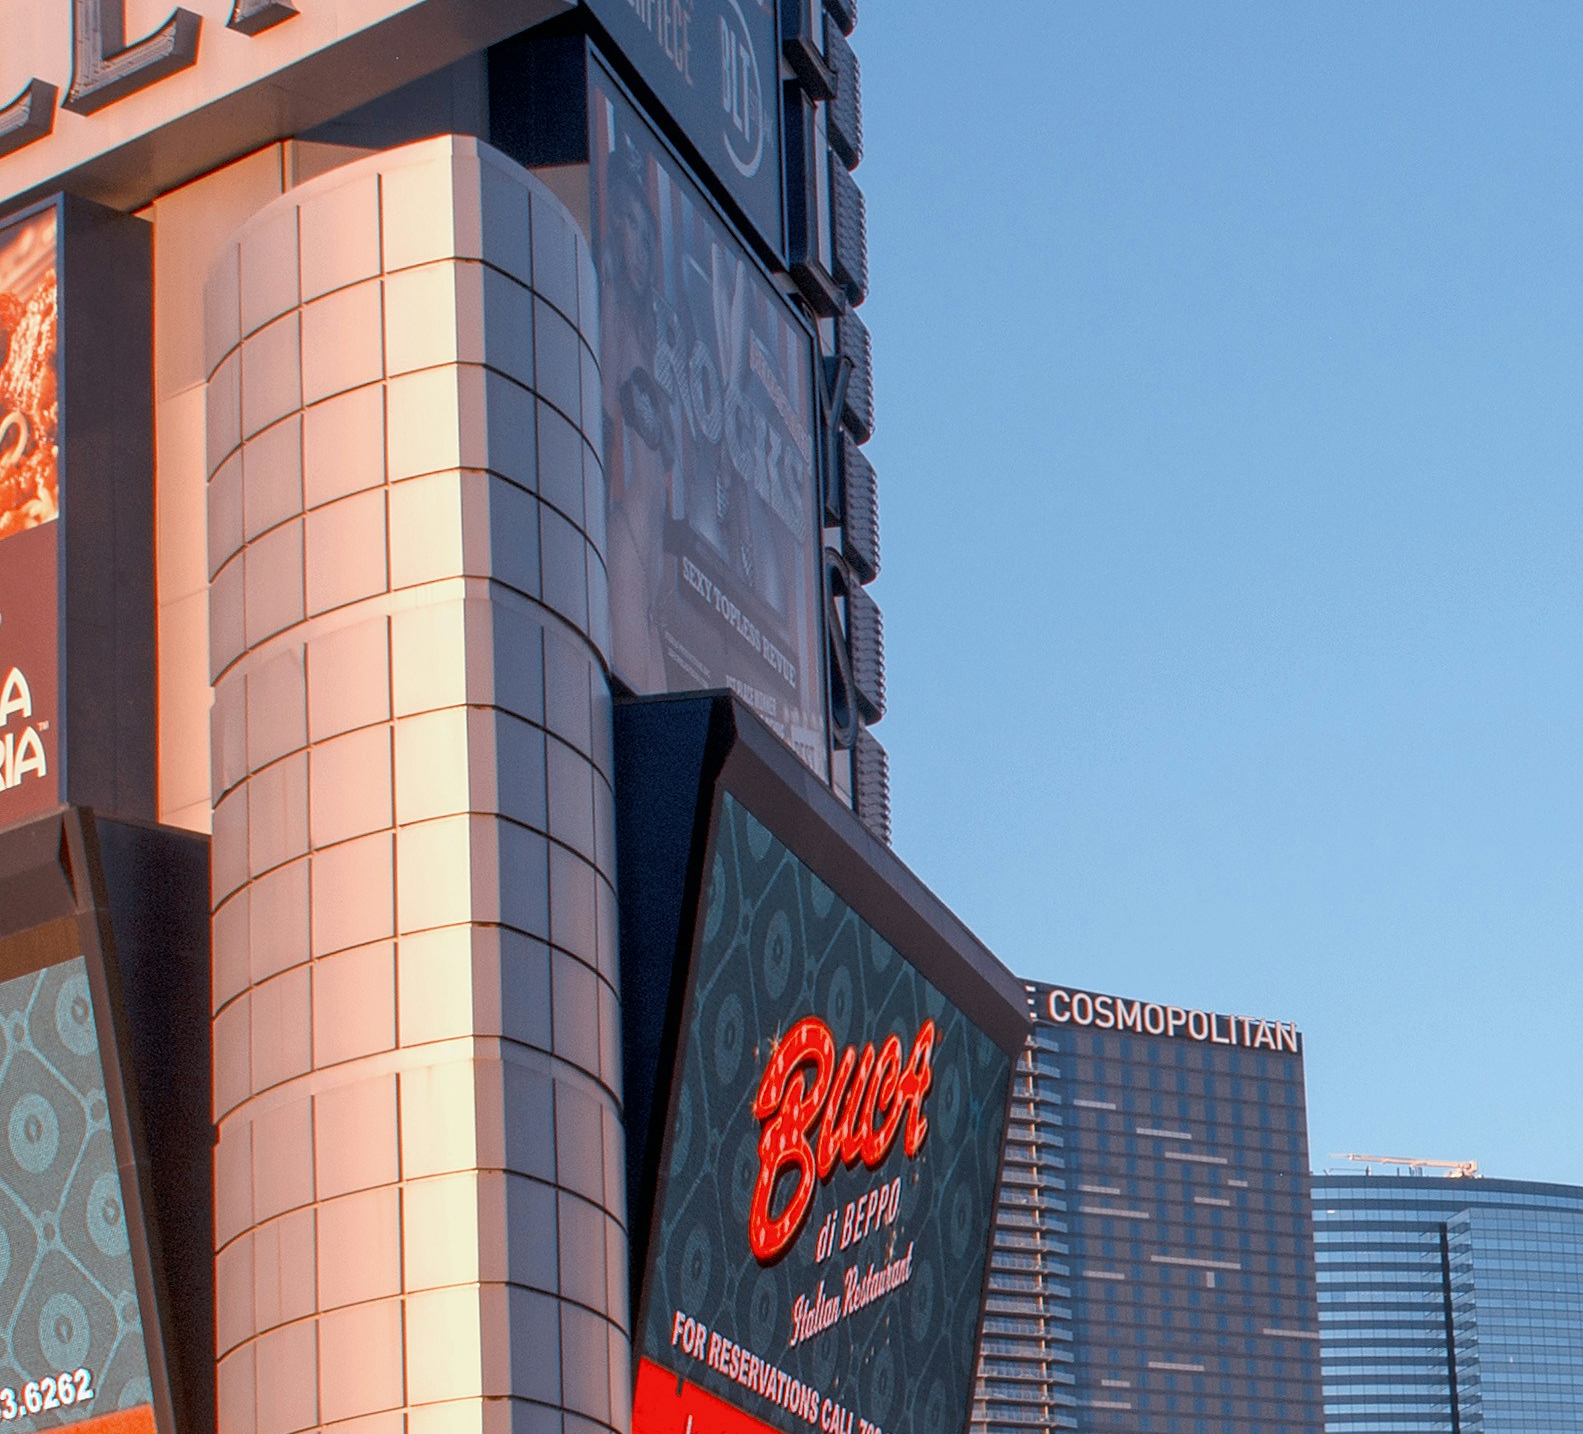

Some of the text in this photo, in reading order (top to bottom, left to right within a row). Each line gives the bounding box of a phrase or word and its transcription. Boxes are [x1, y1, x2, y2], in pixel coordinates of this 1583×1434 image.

[720, 15, 750, 142] BLT
[682, 556, 712, 602] SEXY
[714, 585, 760, 652] TOPLESS
[762, 635, 797, 688] REVUE
[1047, 988, 1299, 1053] COSMOPOLITAN
[815, 1177, 901, 1264] di BEPPO
[789, 1241, 915, 1348] Italian Restaurant
[671, 1310, 706, 1361] FOR
[707, 1331, 819, 1425] RESERVATIONS
